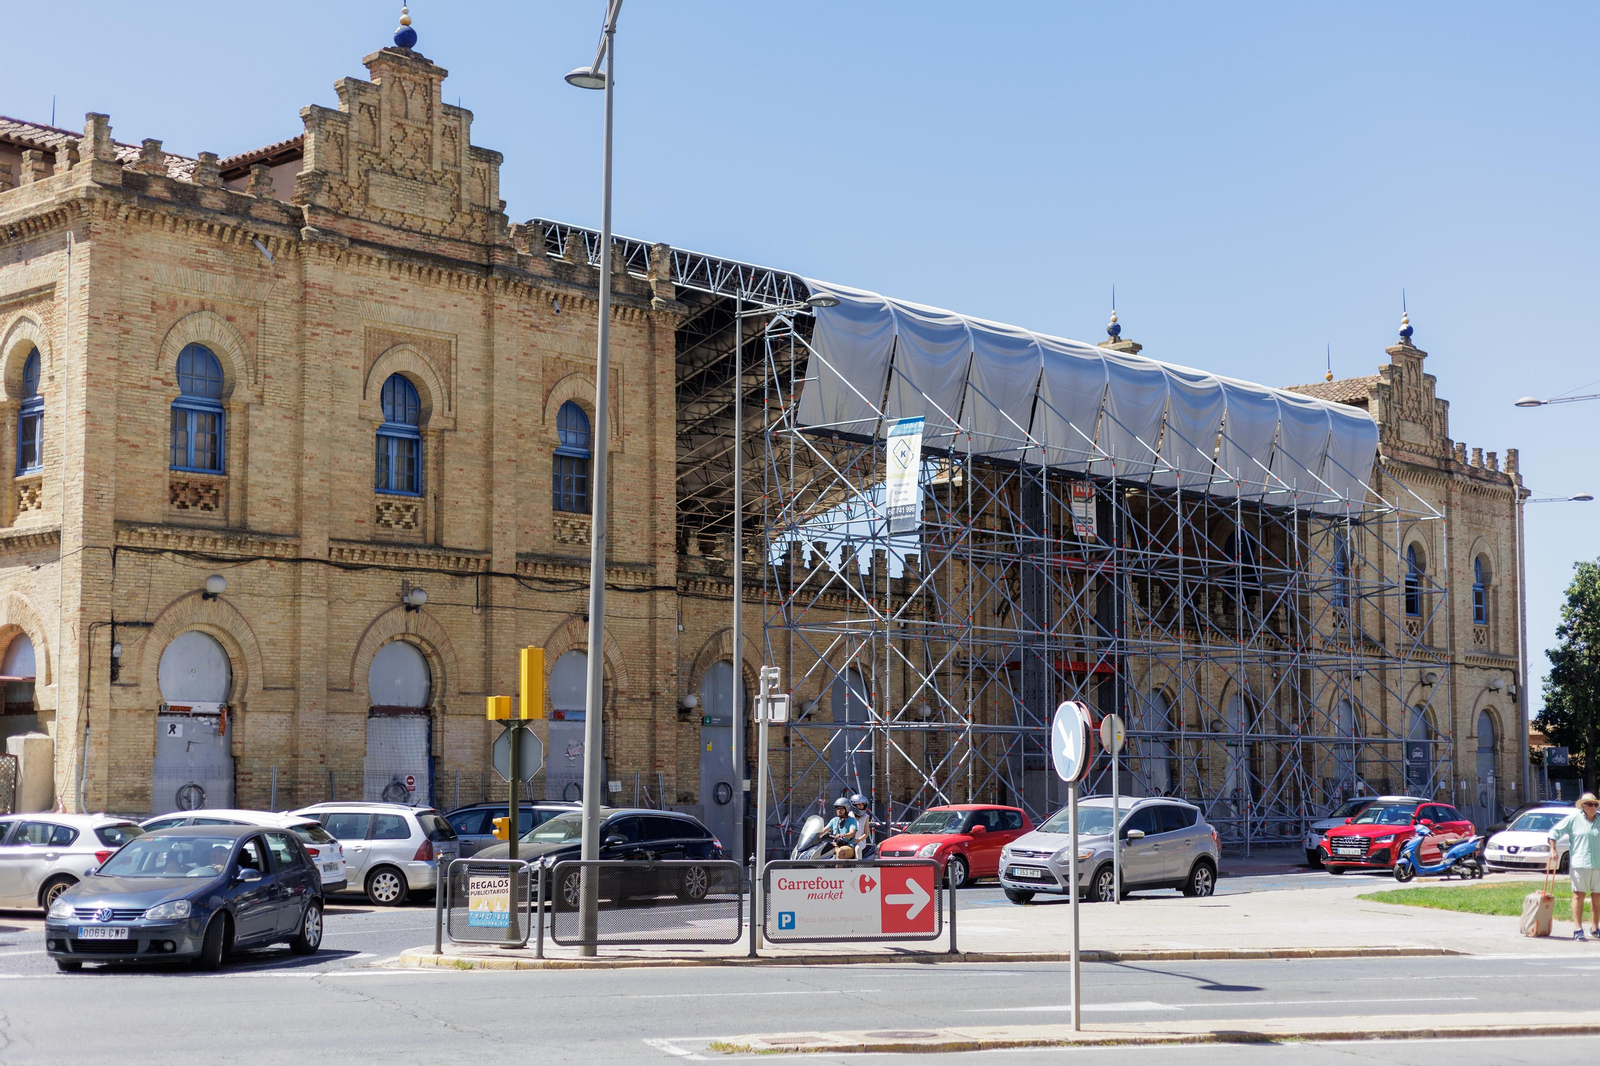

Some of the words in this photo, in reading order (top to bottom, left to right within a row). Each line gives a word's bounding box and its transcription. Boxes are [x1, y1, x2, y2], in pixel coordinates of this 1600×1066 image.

[900, 450, 907, 458] K
[471, 880, 508, 889] REGALOS
[778, 876, 844, 890] Carrefour
[807, 890, 844, 900] market
[781, 913, 792, 928] P
[83, 928, 105, 937] 0069
